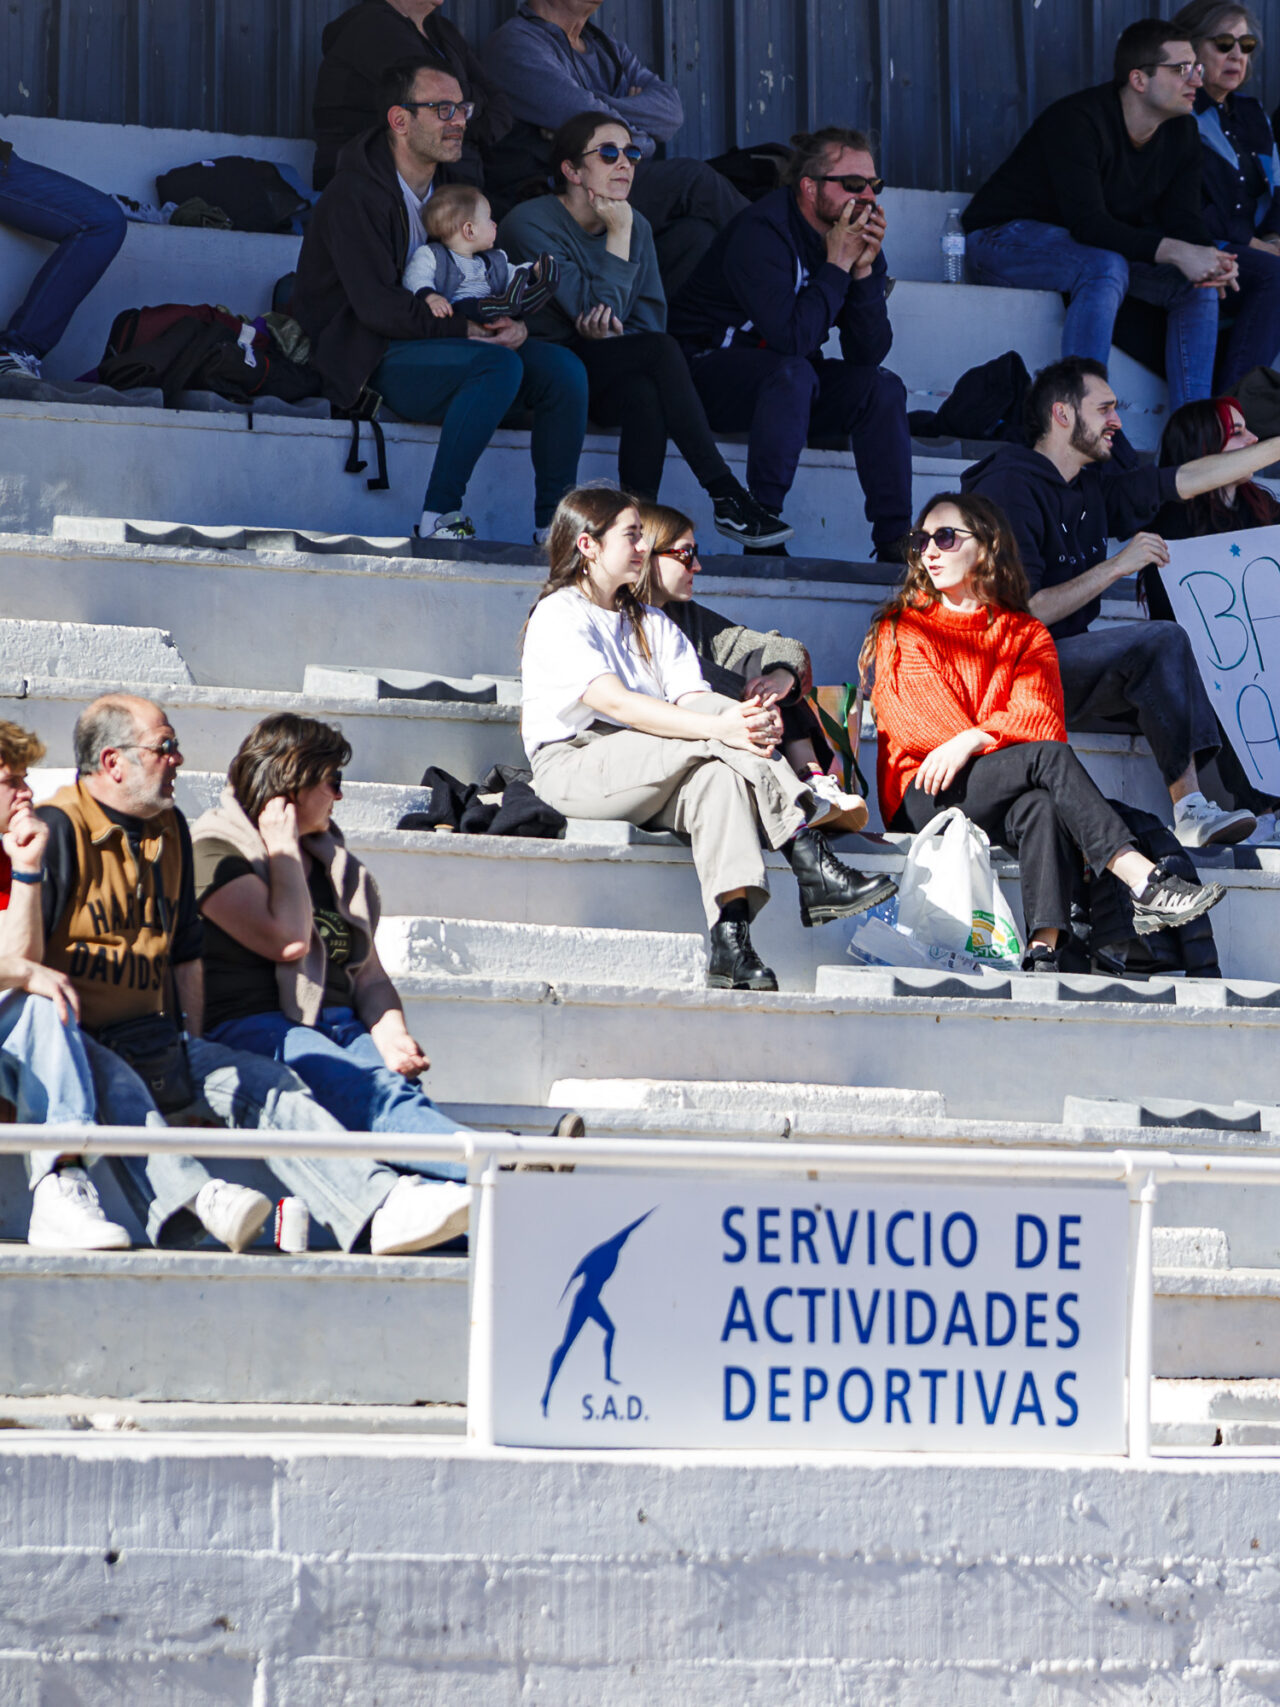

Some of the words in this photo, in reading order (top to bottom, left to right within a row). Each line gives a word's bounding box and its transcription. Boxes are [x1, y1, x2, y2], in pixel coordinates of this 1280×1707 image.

[721, 1205, 979, 1269] SERVICIO
[1015, 1213, 1083, 1271] DE
[720, 1285, 1081, 1349] ACTIVIDADES
[582, 1393, 650, 1421] S.A.D.
[723, 1365, 1080, 1428] DEPORTIVAS
